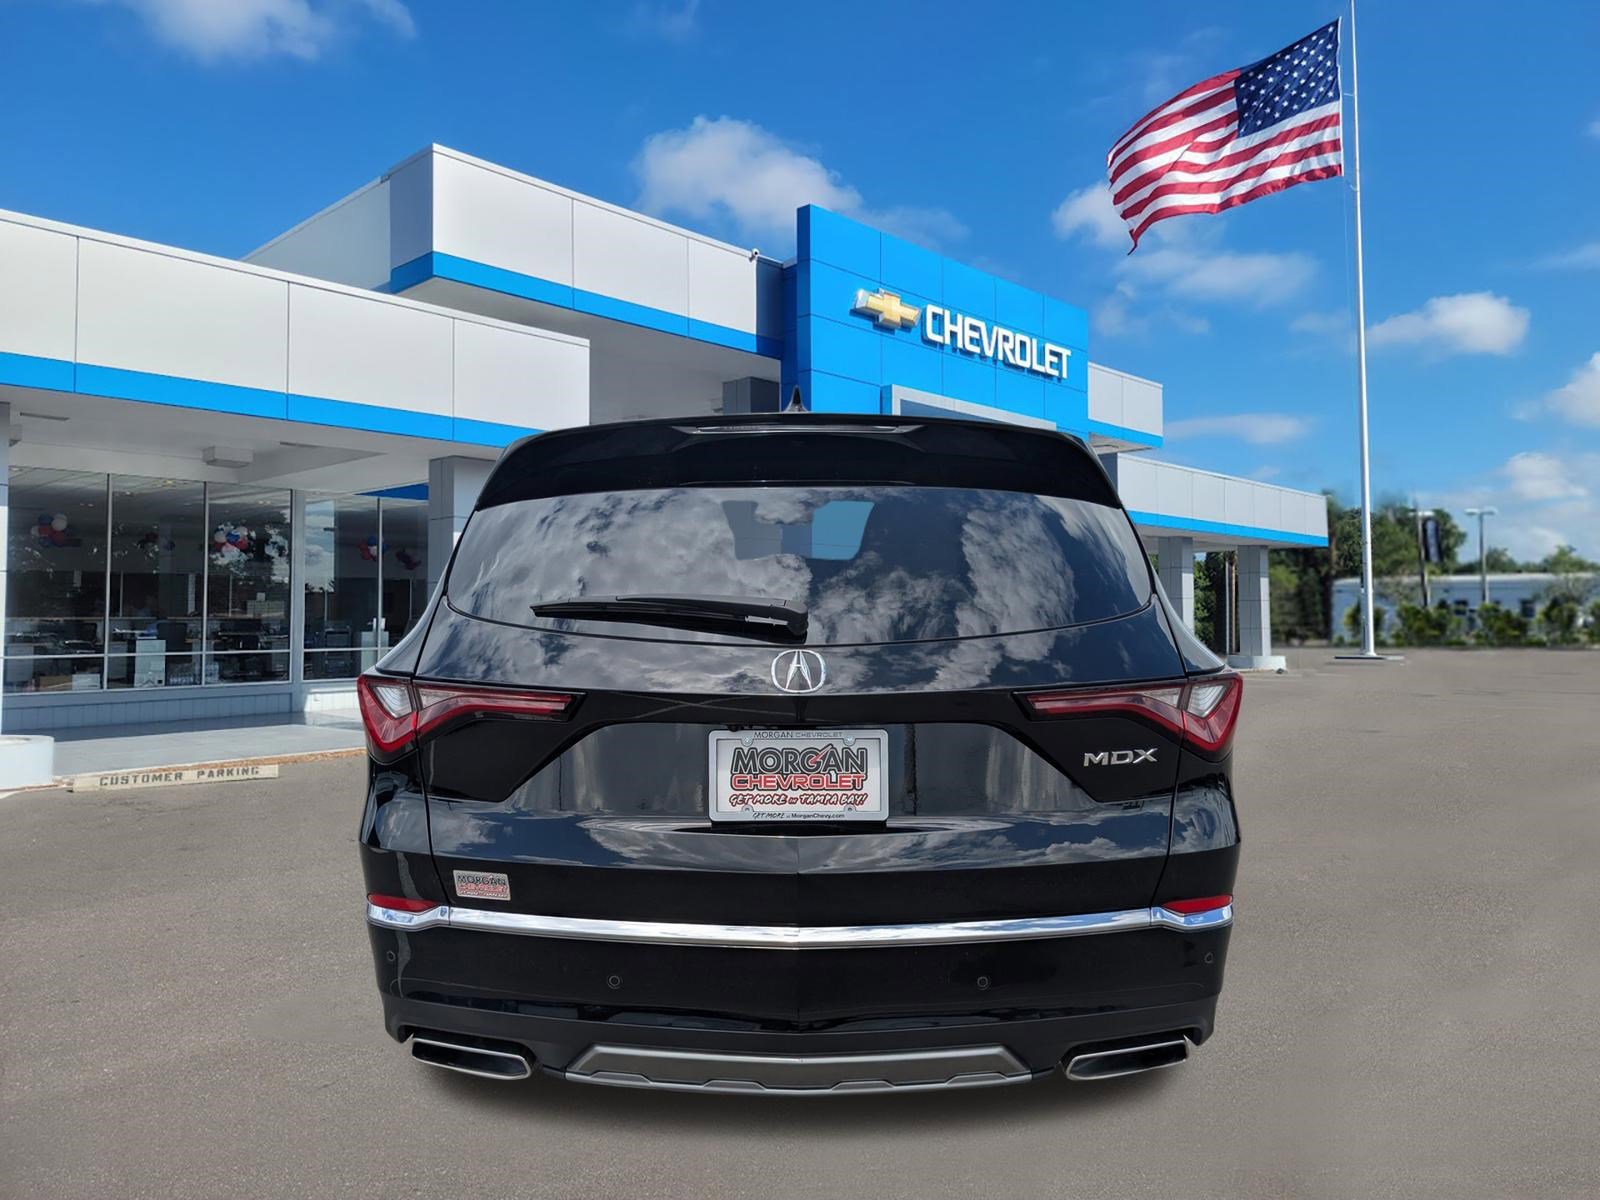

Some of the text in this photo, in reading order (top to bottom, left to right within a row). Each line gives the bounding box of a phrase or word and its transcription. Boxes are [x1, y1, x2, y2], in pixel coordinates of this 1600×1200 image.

[925, 304, 1071, 378] CHEVROLET
[731, 746, 867, 773] MORGAN
[1083, 748, 1158, 767] MDX
[100, 766, 259, 786] CUSTOMER PARKING
[732, 774, 865, 790] CHEVROLET
[729, 793, 752, 806] GET
[752, 793, 787, 805] MORE
[799, 793, 839, 805] TAMPA
[839, 793, 868, 805] BAY!
